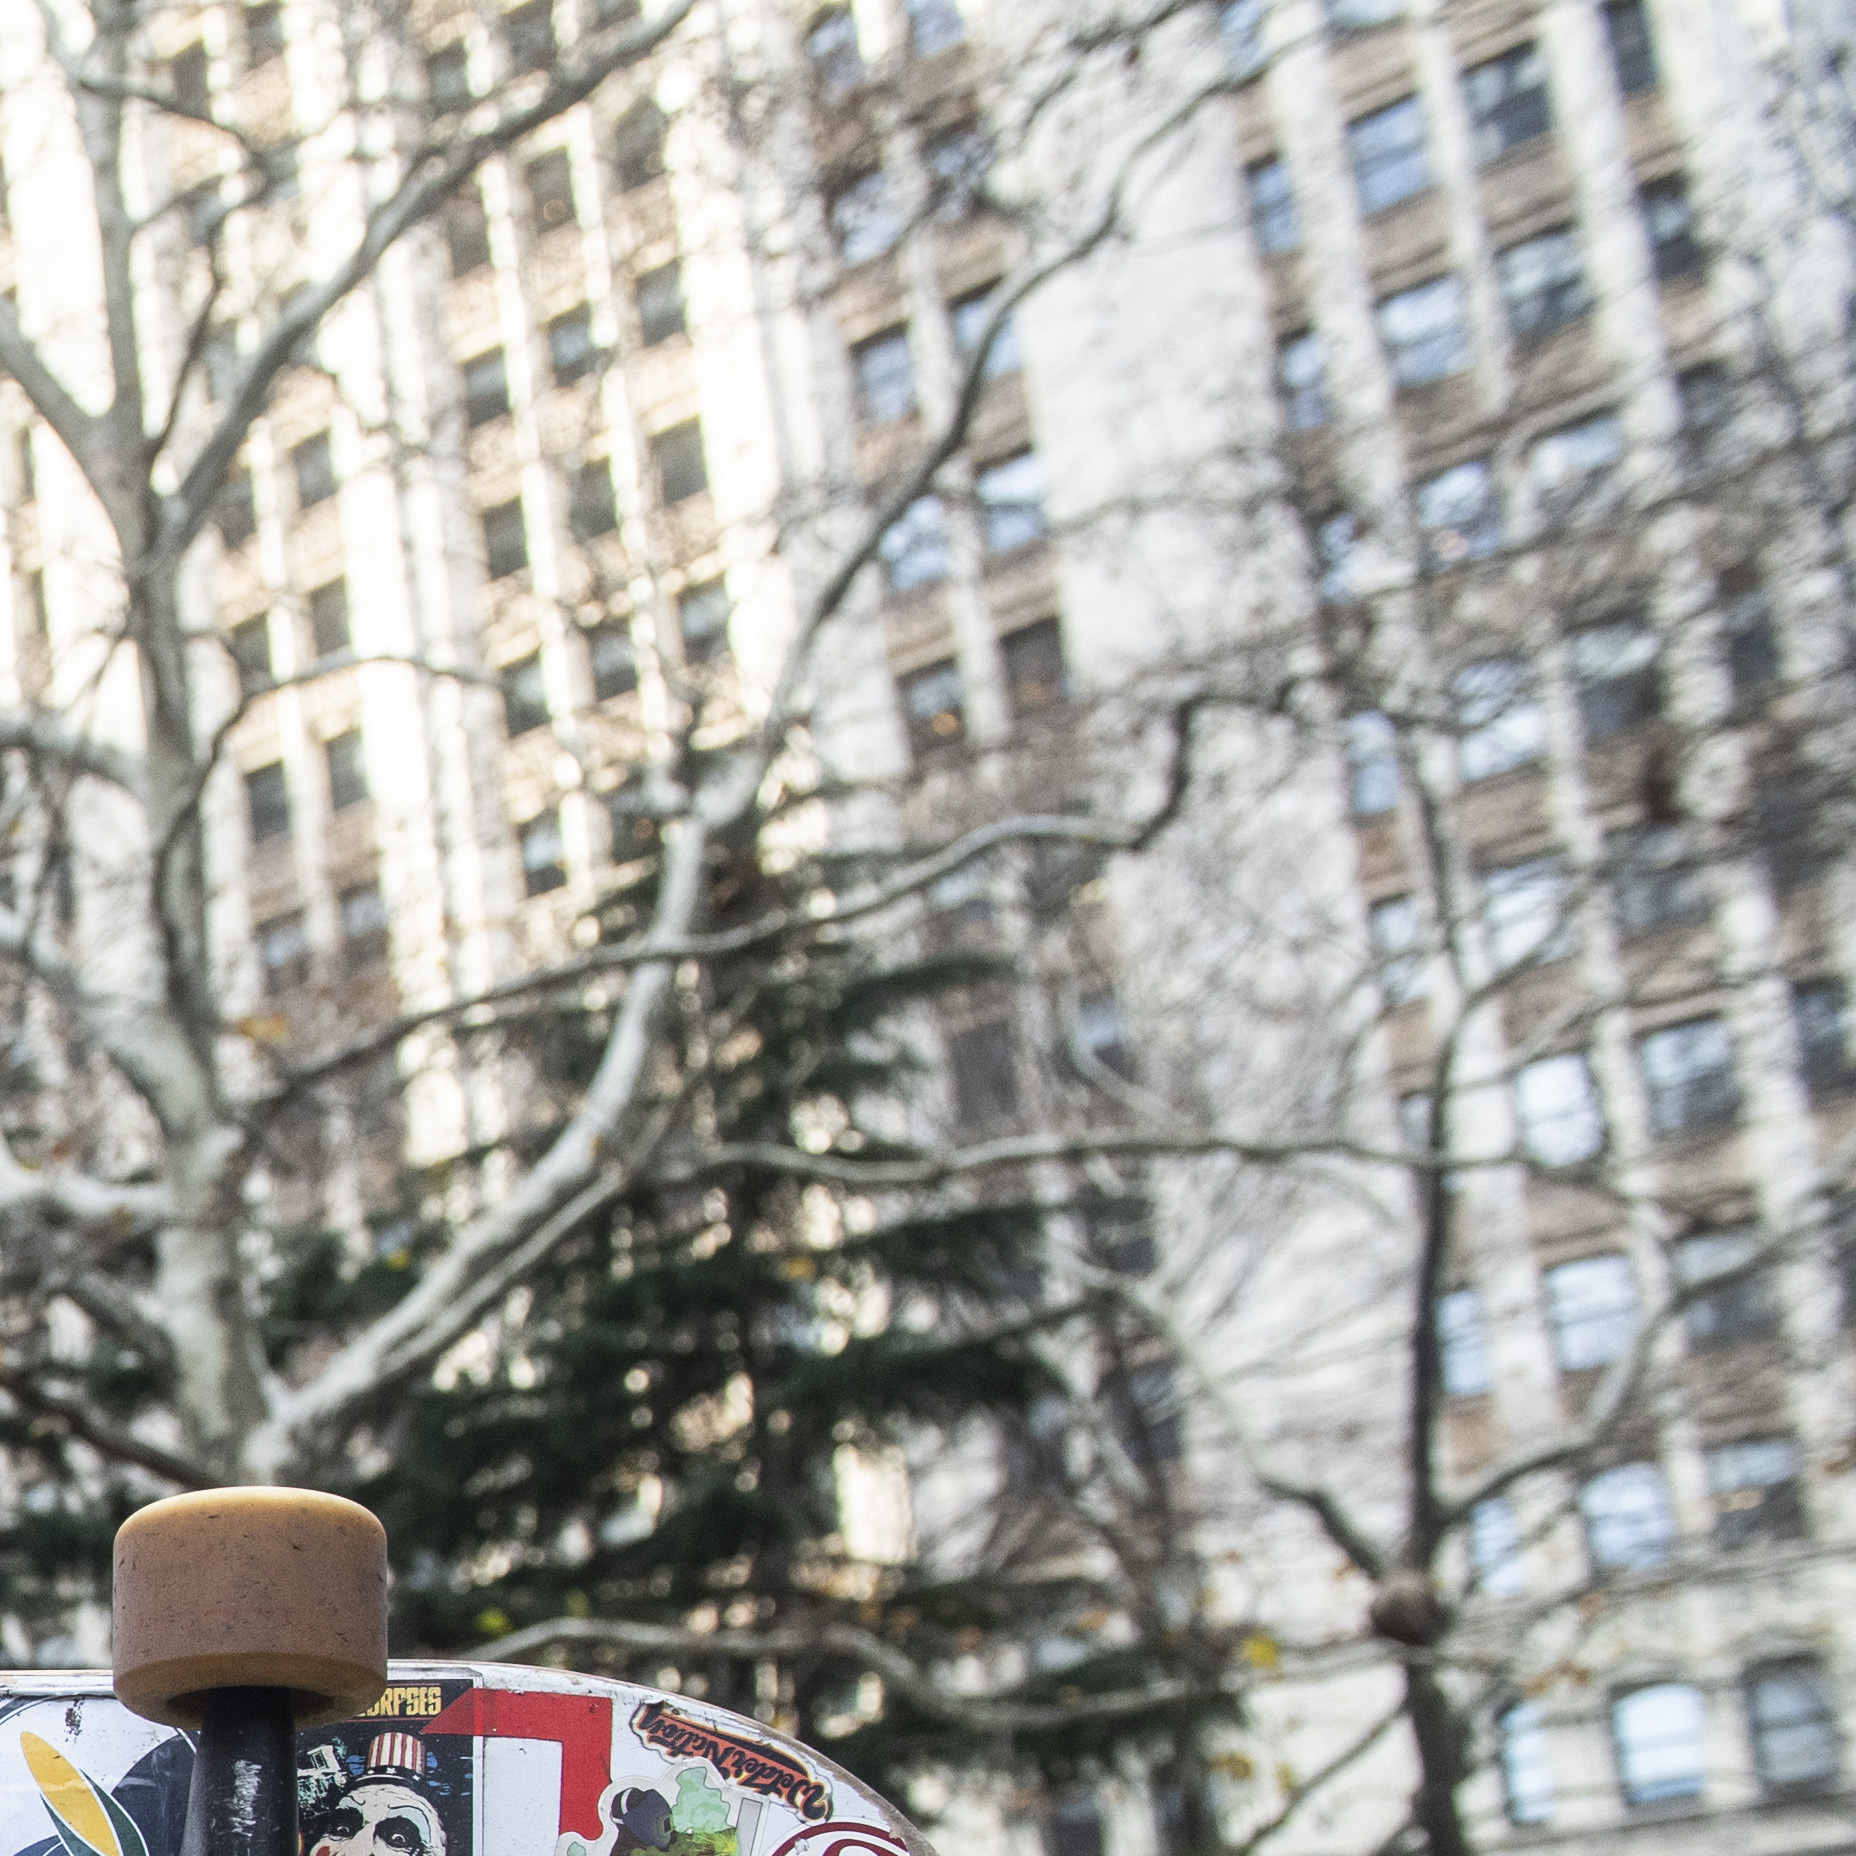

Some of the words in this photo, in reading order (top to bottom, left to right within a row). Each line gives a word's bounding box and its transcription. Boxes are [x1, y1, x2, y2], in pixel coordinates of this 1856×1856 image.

[356, 1687, 442, 1717] RPSES
[636, 1702, 734, 1779] Nation
[728, 1748, 832, 1822] Welder
